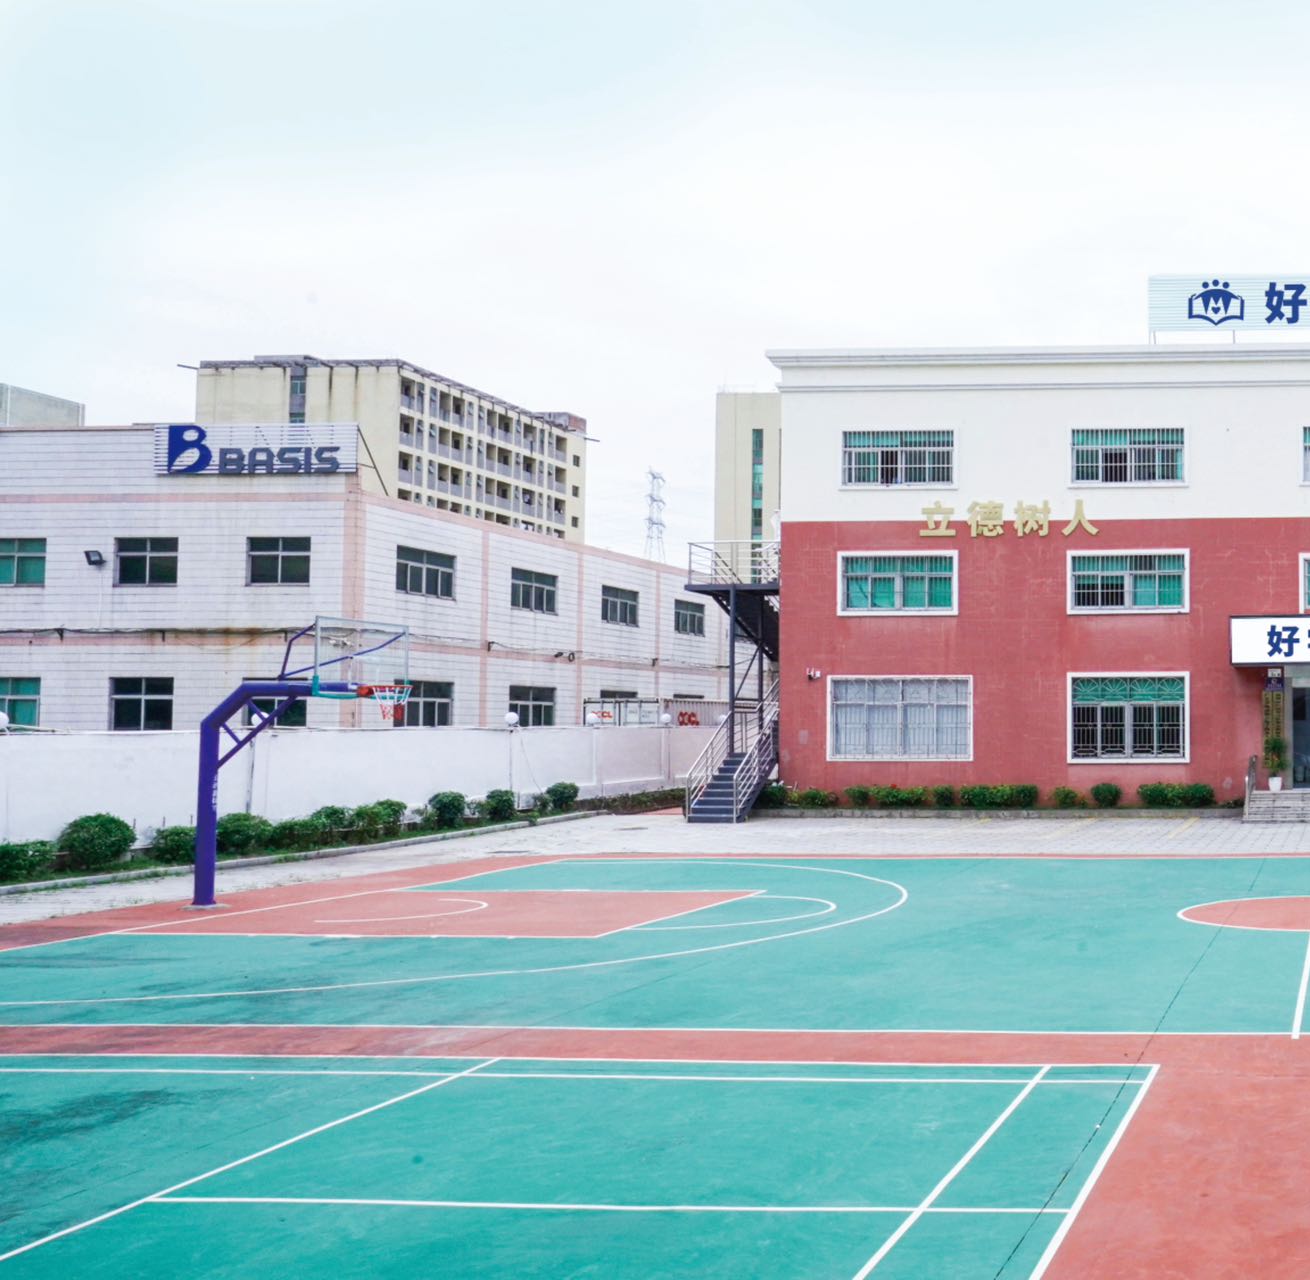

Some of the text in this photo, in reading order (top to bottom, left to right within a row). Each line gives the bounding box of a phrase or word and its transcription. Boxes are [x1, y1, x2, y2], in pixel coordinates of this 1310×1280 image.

[219, 447, 341, 474] BASIS
[919, 499, 1099, 537] 立德树人
